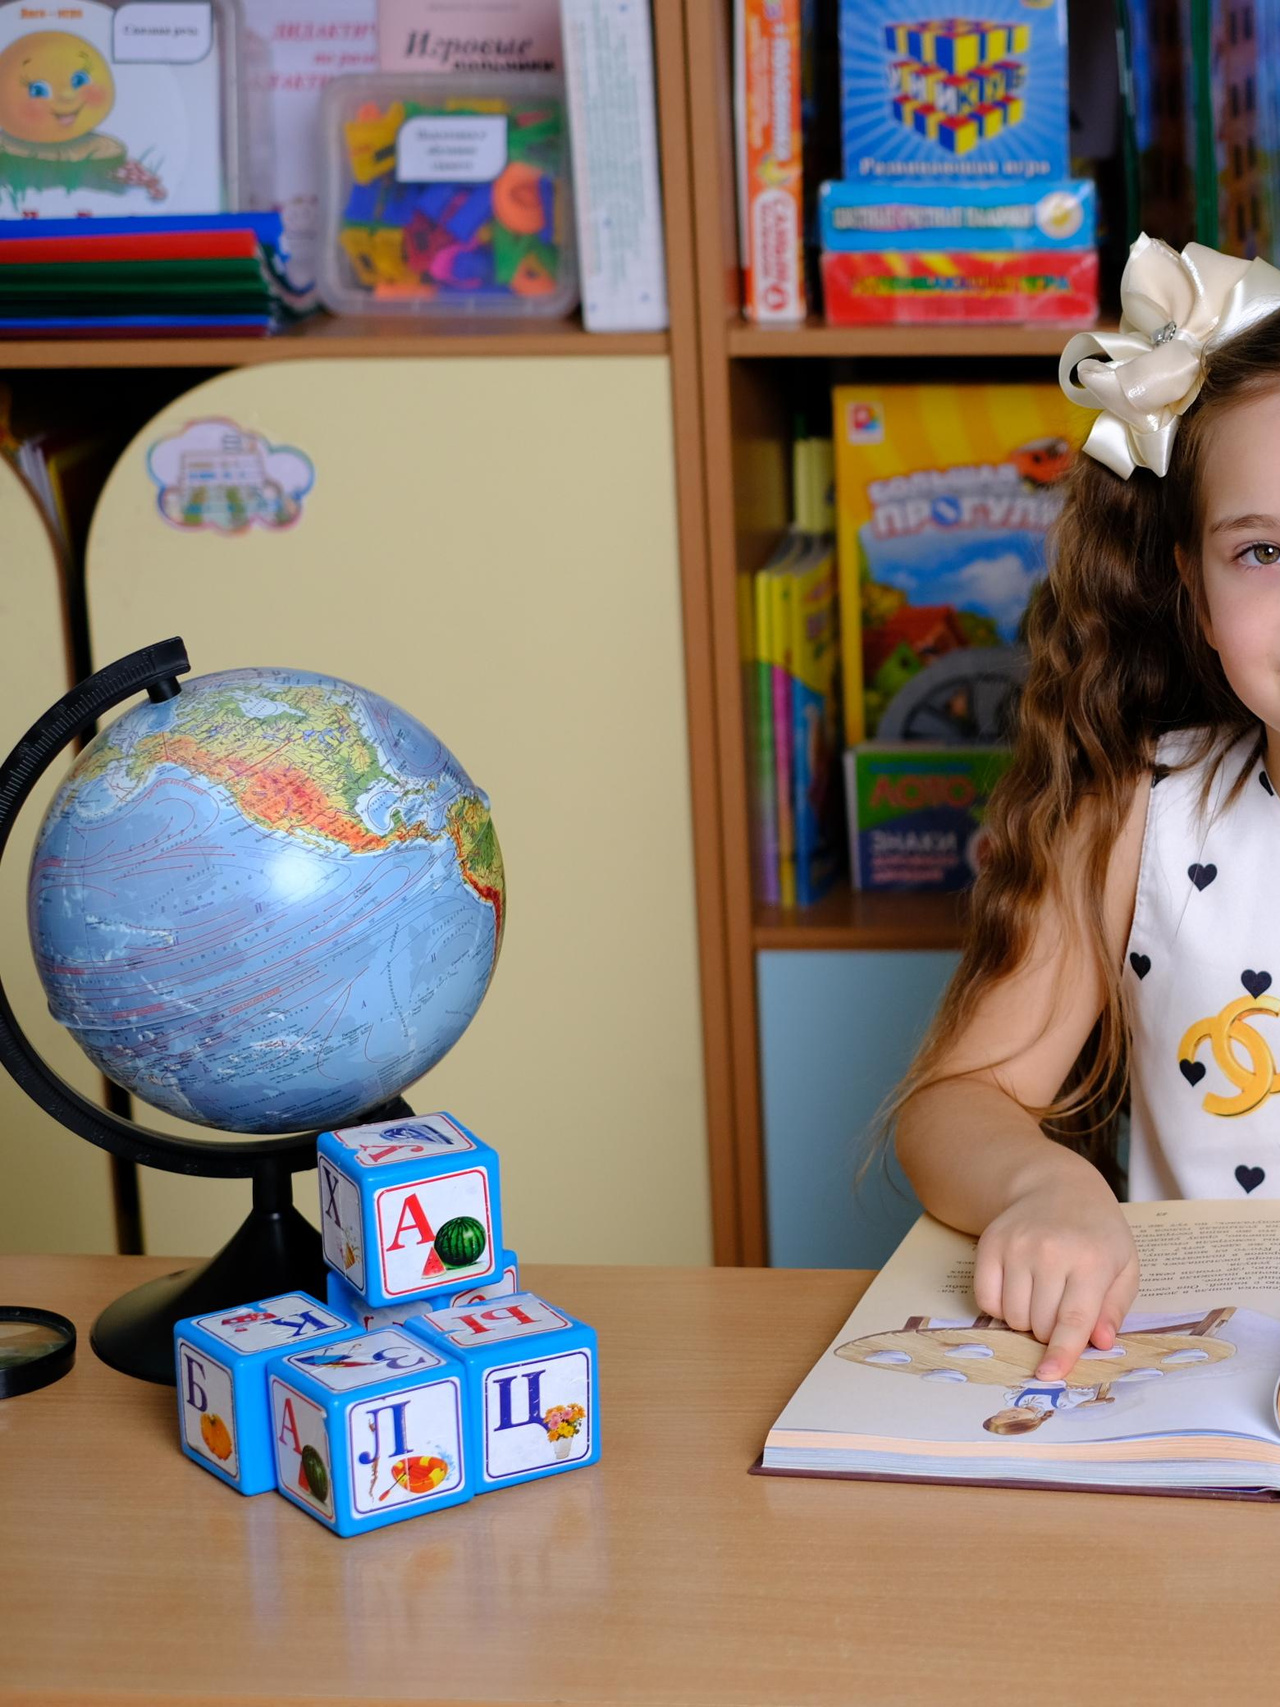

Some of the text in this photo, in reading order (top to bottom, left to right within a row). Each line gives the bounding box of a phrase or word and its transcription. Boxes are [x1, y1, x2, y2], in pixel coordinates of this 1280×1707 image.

[404, 29, 534, 63] Игровые
[321, 1164, 343, 1229] Х
[385, 1192, 437, 1252] А
[263, 1309, 339, 1340] К
[184, 1353, 209, 1413] Б
[372, 1346, 426, 1370] З
[278, 1397, 302, 1456] А
[493, 1369, 550, 1433] Ц
[358, 1400, 415, 1465] Л
